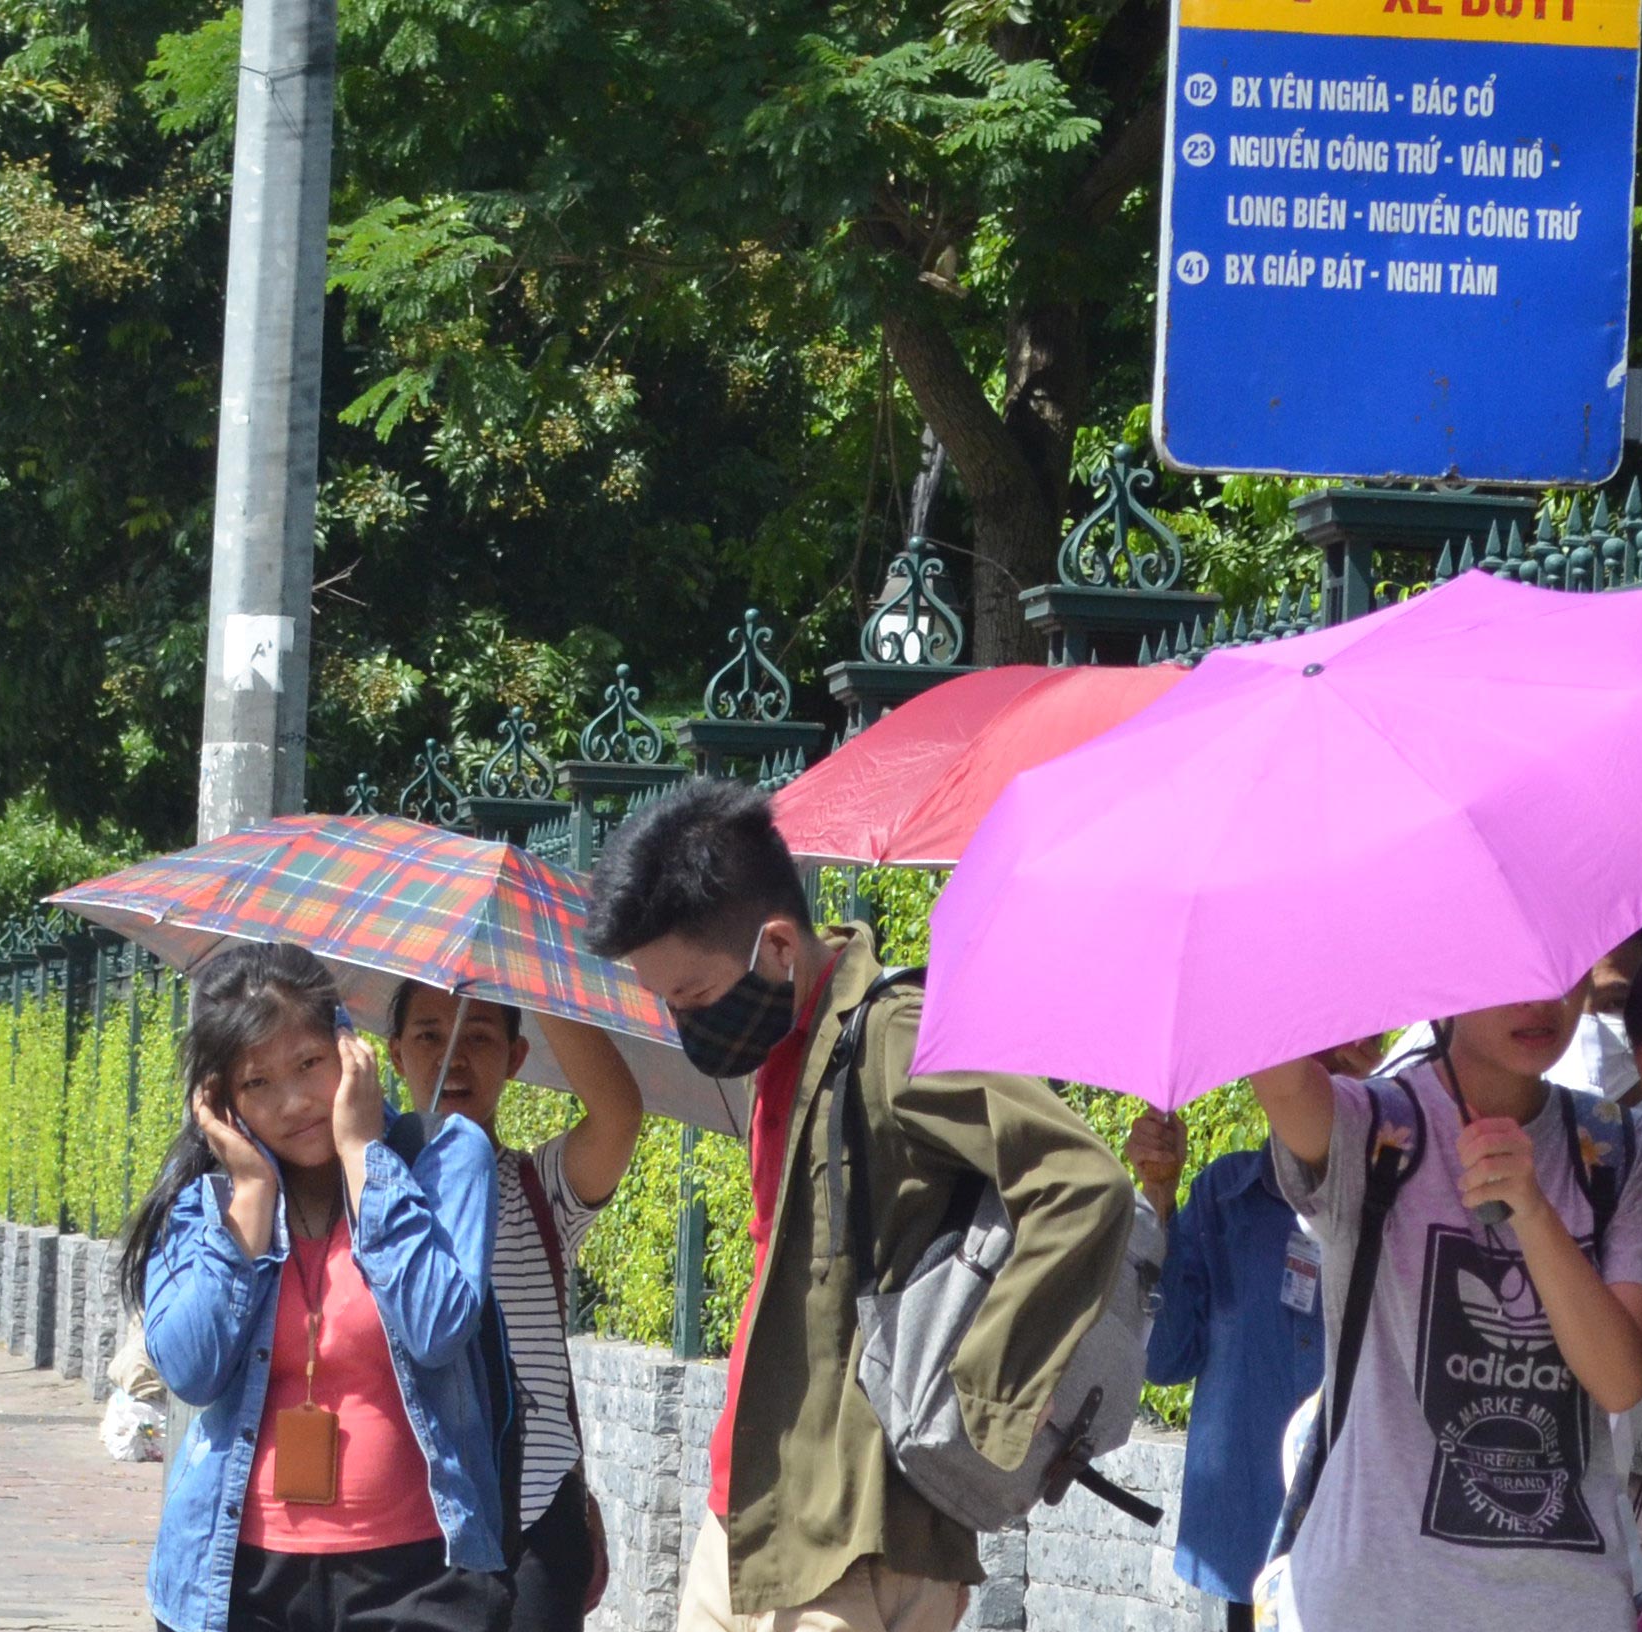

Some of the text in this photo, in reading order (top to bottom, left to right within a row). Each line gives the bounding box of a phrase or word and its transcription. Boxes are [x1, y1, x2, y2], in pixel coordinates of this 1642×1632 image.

[1189, 80, 1212, 100] 02
[1231, 76, 1263, 107] BX
[1269, 72, 1314, 110] YÊN
[1319, 74, 1390, 113] NGHĨA
[1412, 77, 1458, 116] BÁC
[1464, 73, 1497, 117] CỔ
[1187, 140, 1209, 160] 23
[1229, 127, 1320, 170] NGUYỄN
[1326, 134, 1389, 173] CÔNG
[1395, 134, 1442, 175] TRỨ
[1460, 140, 1506, 177] VÂN
[1512, 137, 1543, 179] HỒ
[1227, 195, 1287, 228] LONG
[1292, 192, 1347, 230] BIÊN
[1368, 193, 1461, 236] NGUYỄN
[1466, 200, 1530, 239] CÔNG
[1535, 202, 1582, 241] TRỨ
[1183, 258, 1204, 278] 41
[1225, 254, 1256, 285] BX
[1262, 249, 1316, 287] GIÁP
[1322, 252, 1366, 290] BÁT
[1387, 260, 1443, 293] NGHI
[1449, 257, 1498, 296] TÀM
[1445, 1352, 1573, 1392] adidas
[1459, 1397, 1524, 1427] MARKE
[1493, 1475, 1546, 1491] BRAND
